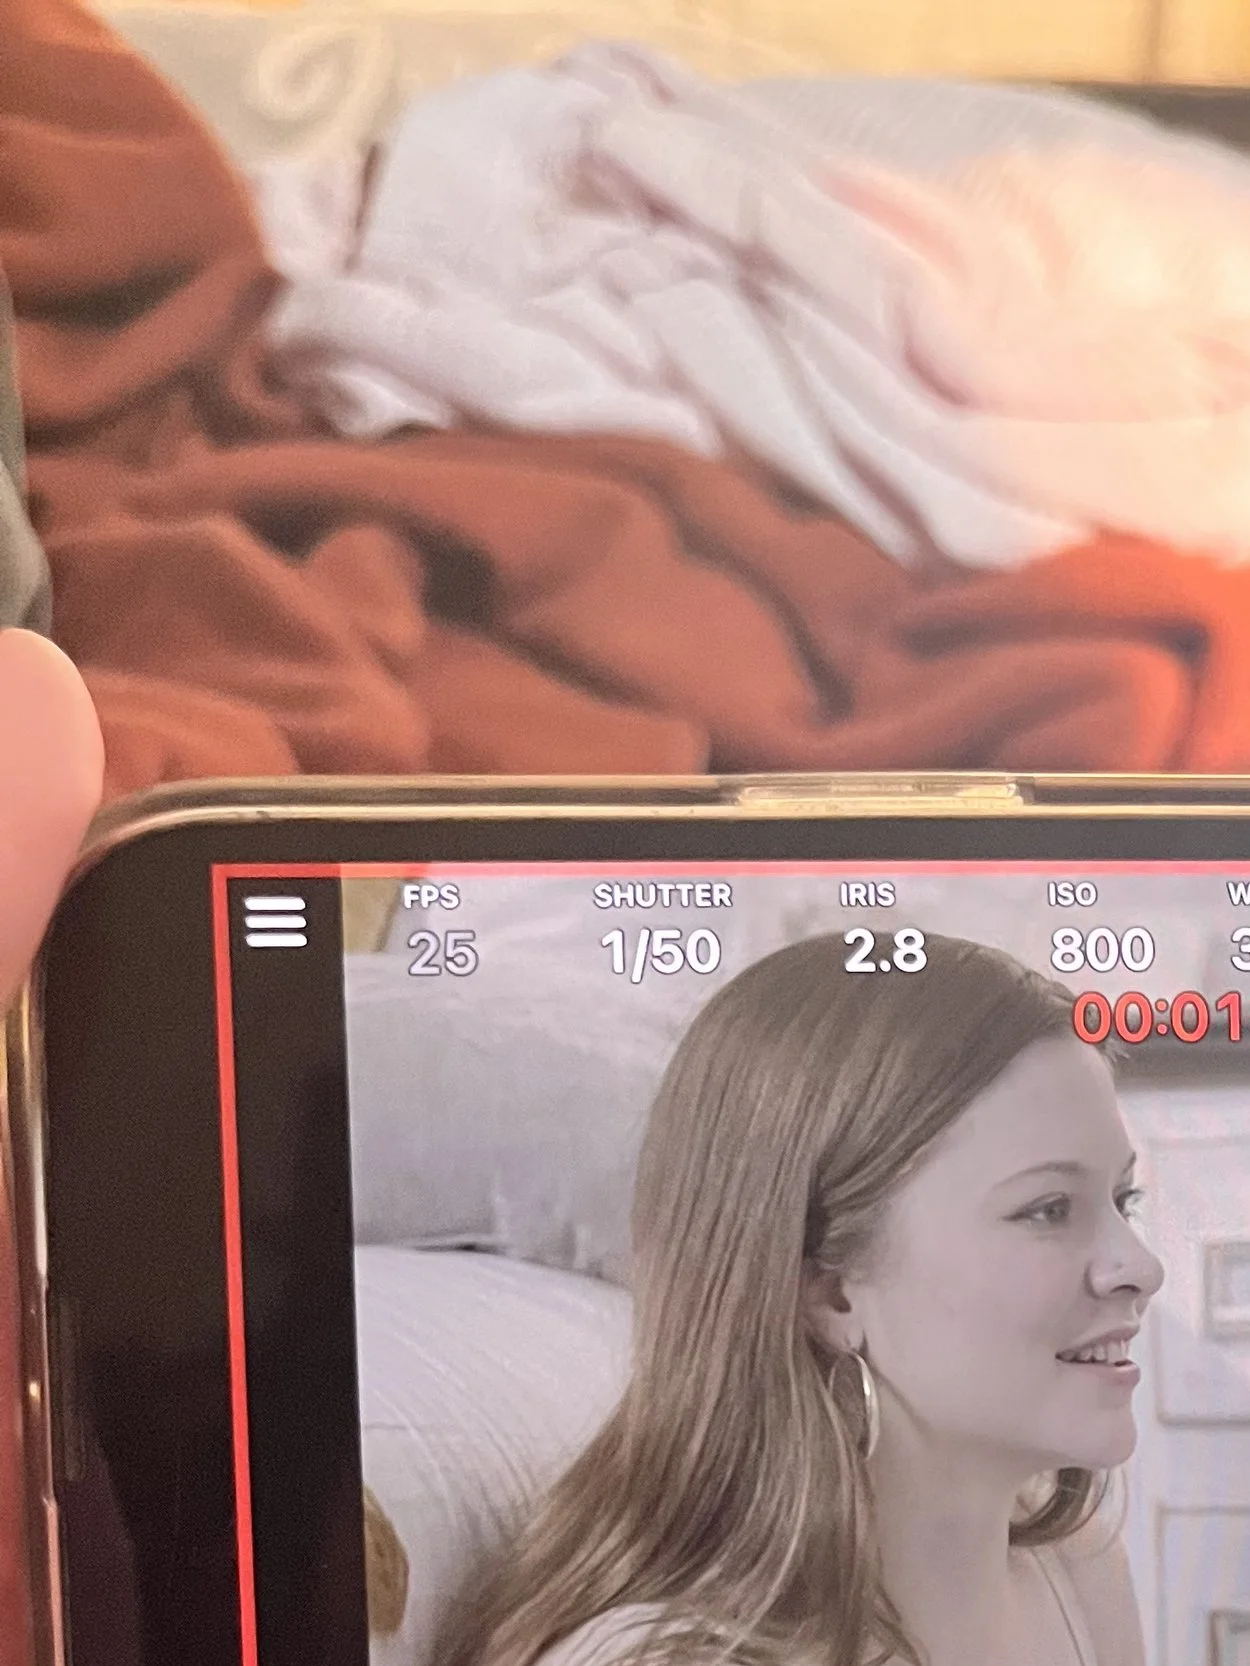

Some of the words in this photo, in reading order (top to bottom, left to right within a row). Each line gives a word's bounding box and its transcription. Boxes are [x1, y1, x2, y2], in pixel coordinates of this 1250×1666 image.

[403, 882, 460, 911] FPS
[593, 881, 733, 909] SHUTTER
[839, 881, 896, 908] IRIS
[1048, 881, 1098, 907] ISO
[406, 931, 479, 977] 25
[600, 927, 722, 984] 1/50
[843, 927, 928, 975] 2.8
[1049, 926, 1156, 974] 800
